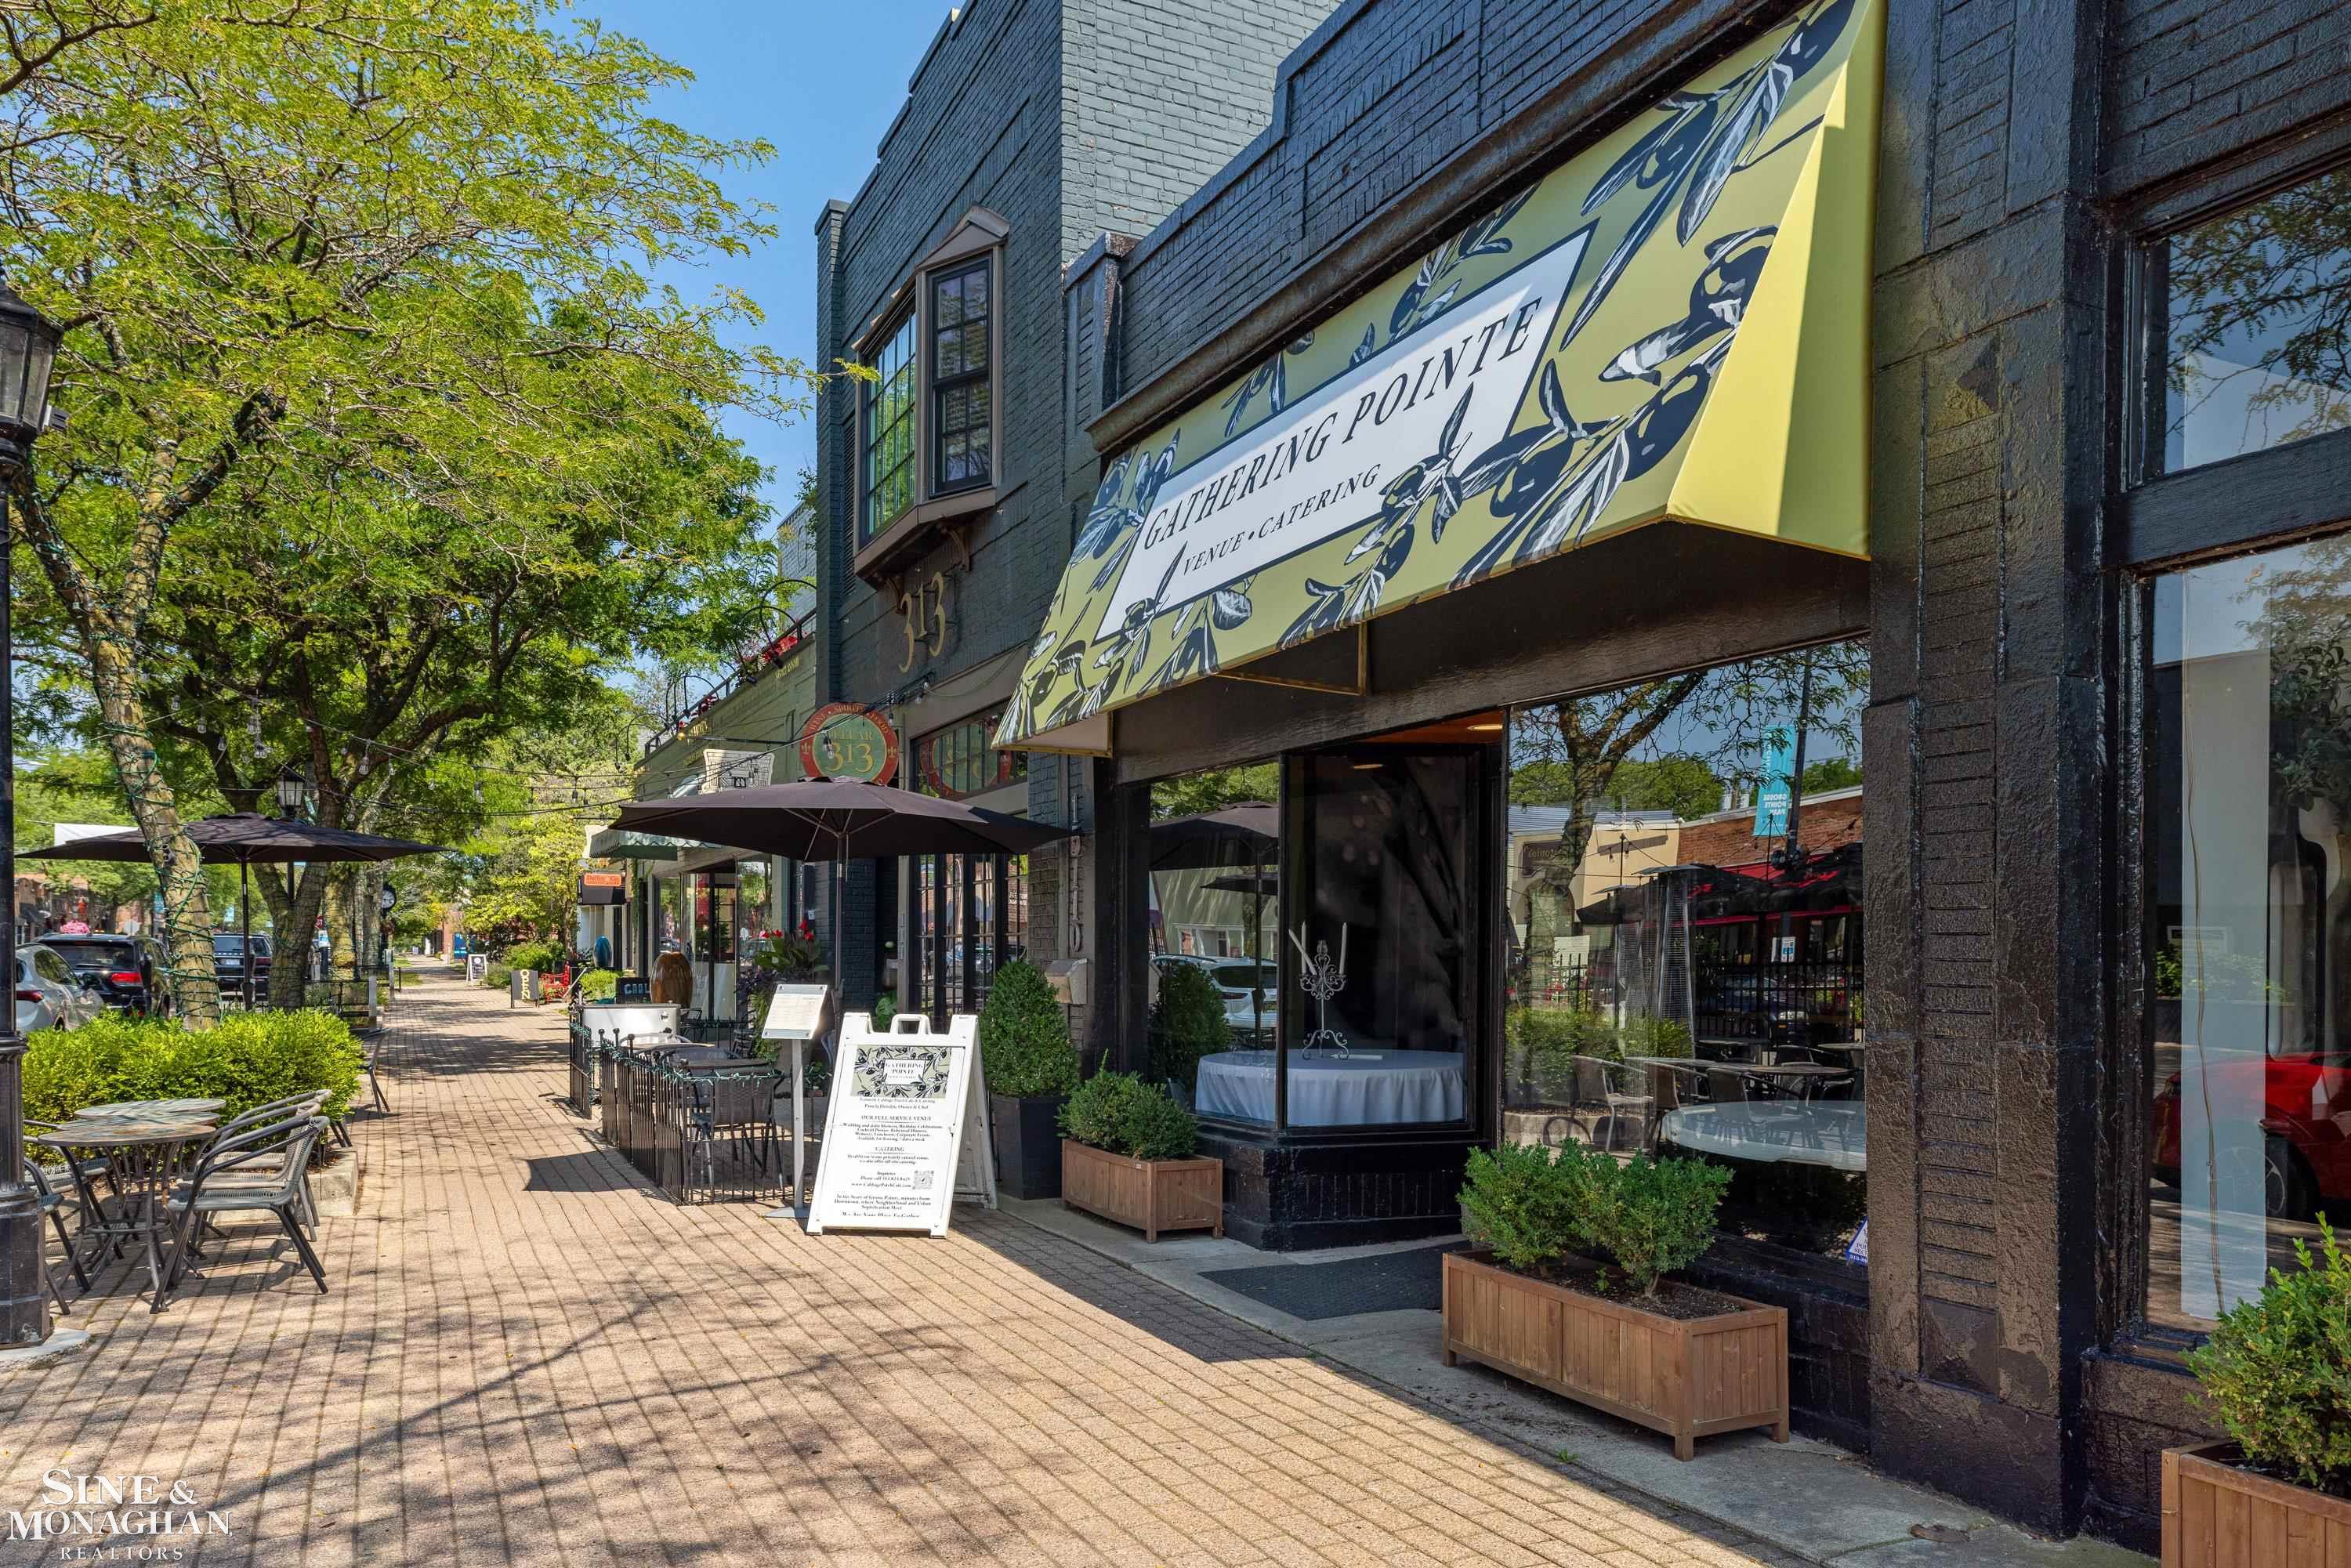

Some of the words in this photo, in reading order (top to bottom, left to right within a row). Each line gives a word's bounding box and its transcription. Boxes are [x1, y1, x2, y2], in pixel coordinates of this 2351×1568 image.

[1143, 412, 1337, 550] GATHERING
[1342, 296, 1542, 444] POINTE
[1183, 532, 1245, 576] VENUE
[1258, 464, 1382, 539] CATERING
[899, 571, 946, 673] 313
[825, 742, 875, 773] 313
[520, 969, 531, 1000] OPEN
